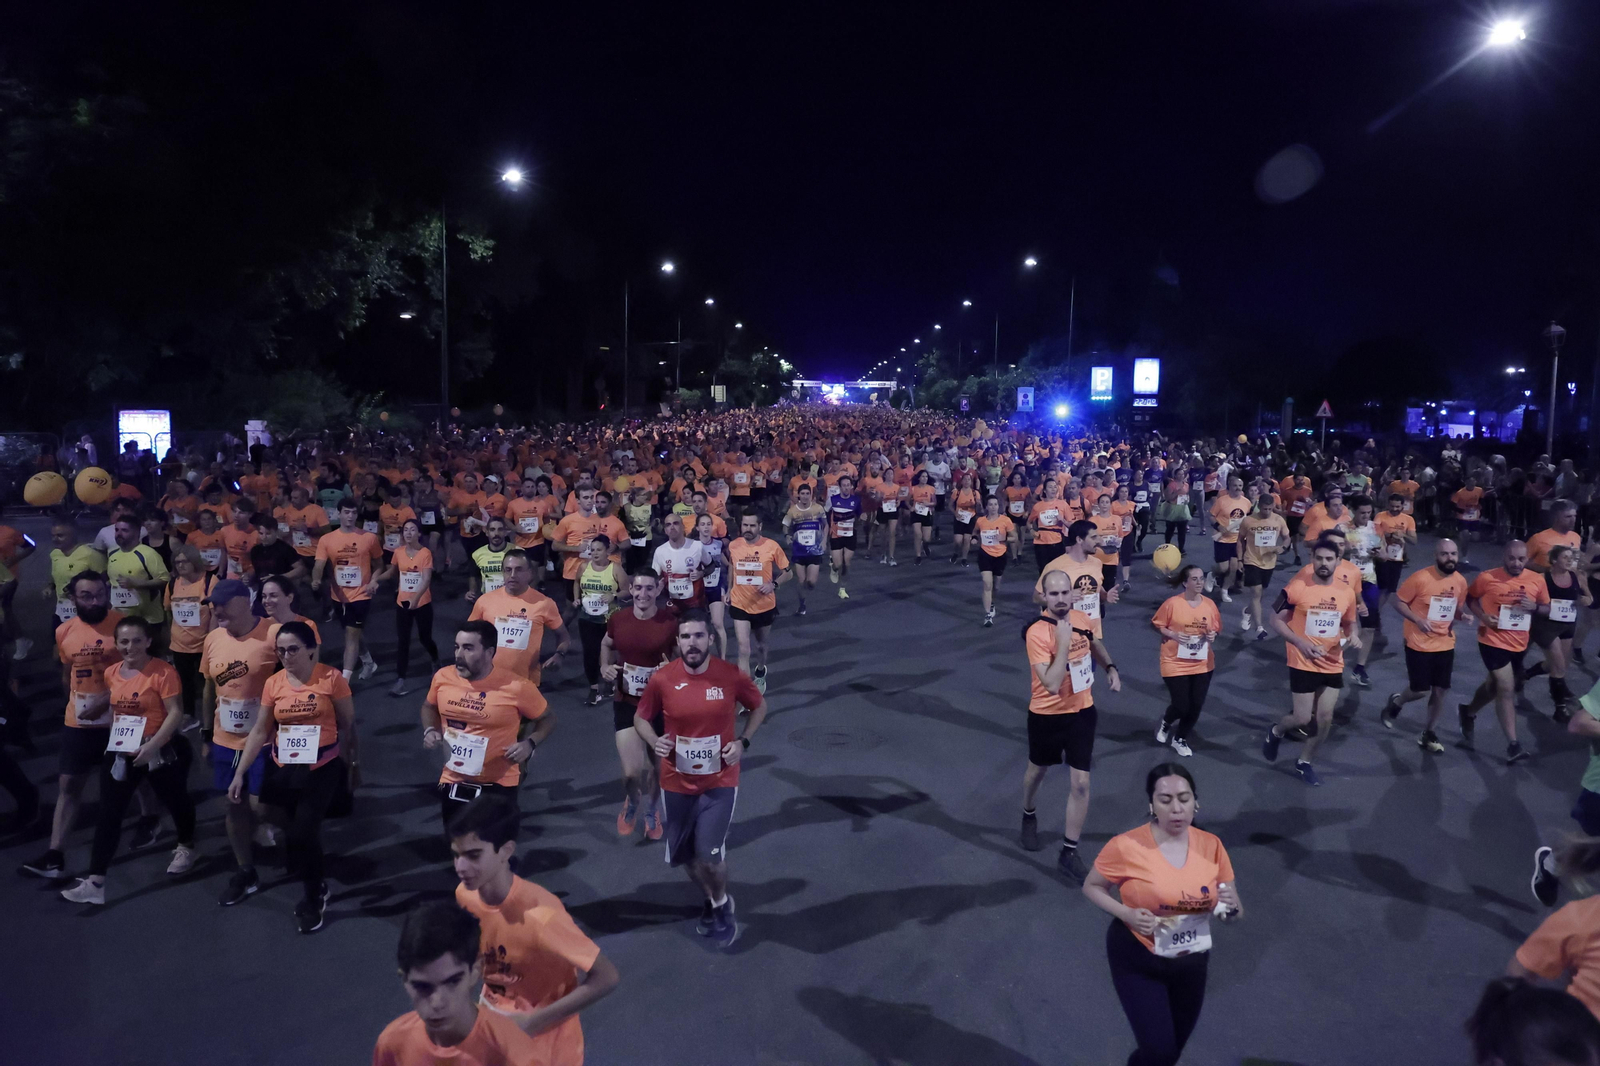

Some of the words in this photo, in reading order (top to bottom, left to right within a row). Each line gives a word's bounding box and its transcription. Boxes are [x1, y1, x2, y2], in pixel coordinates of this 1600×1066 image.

[1096, 369, 1109, 386] P
[502, 627, 524, 637] 11577
[447, 700, 471, 709] SEVILLA
[470, 704, 485, 712] KH7
[460, 698, 486, 707] NOCTURNA
[228, 711, 250, 720] 7682
[114, 727, 135, 738] 11871
[286, 738, 307, 748] 7683
[451, 744, 473, 758] 2611
[685, 749, 713, 760] 15438
[1173, 928, 1198, 946] 9831
